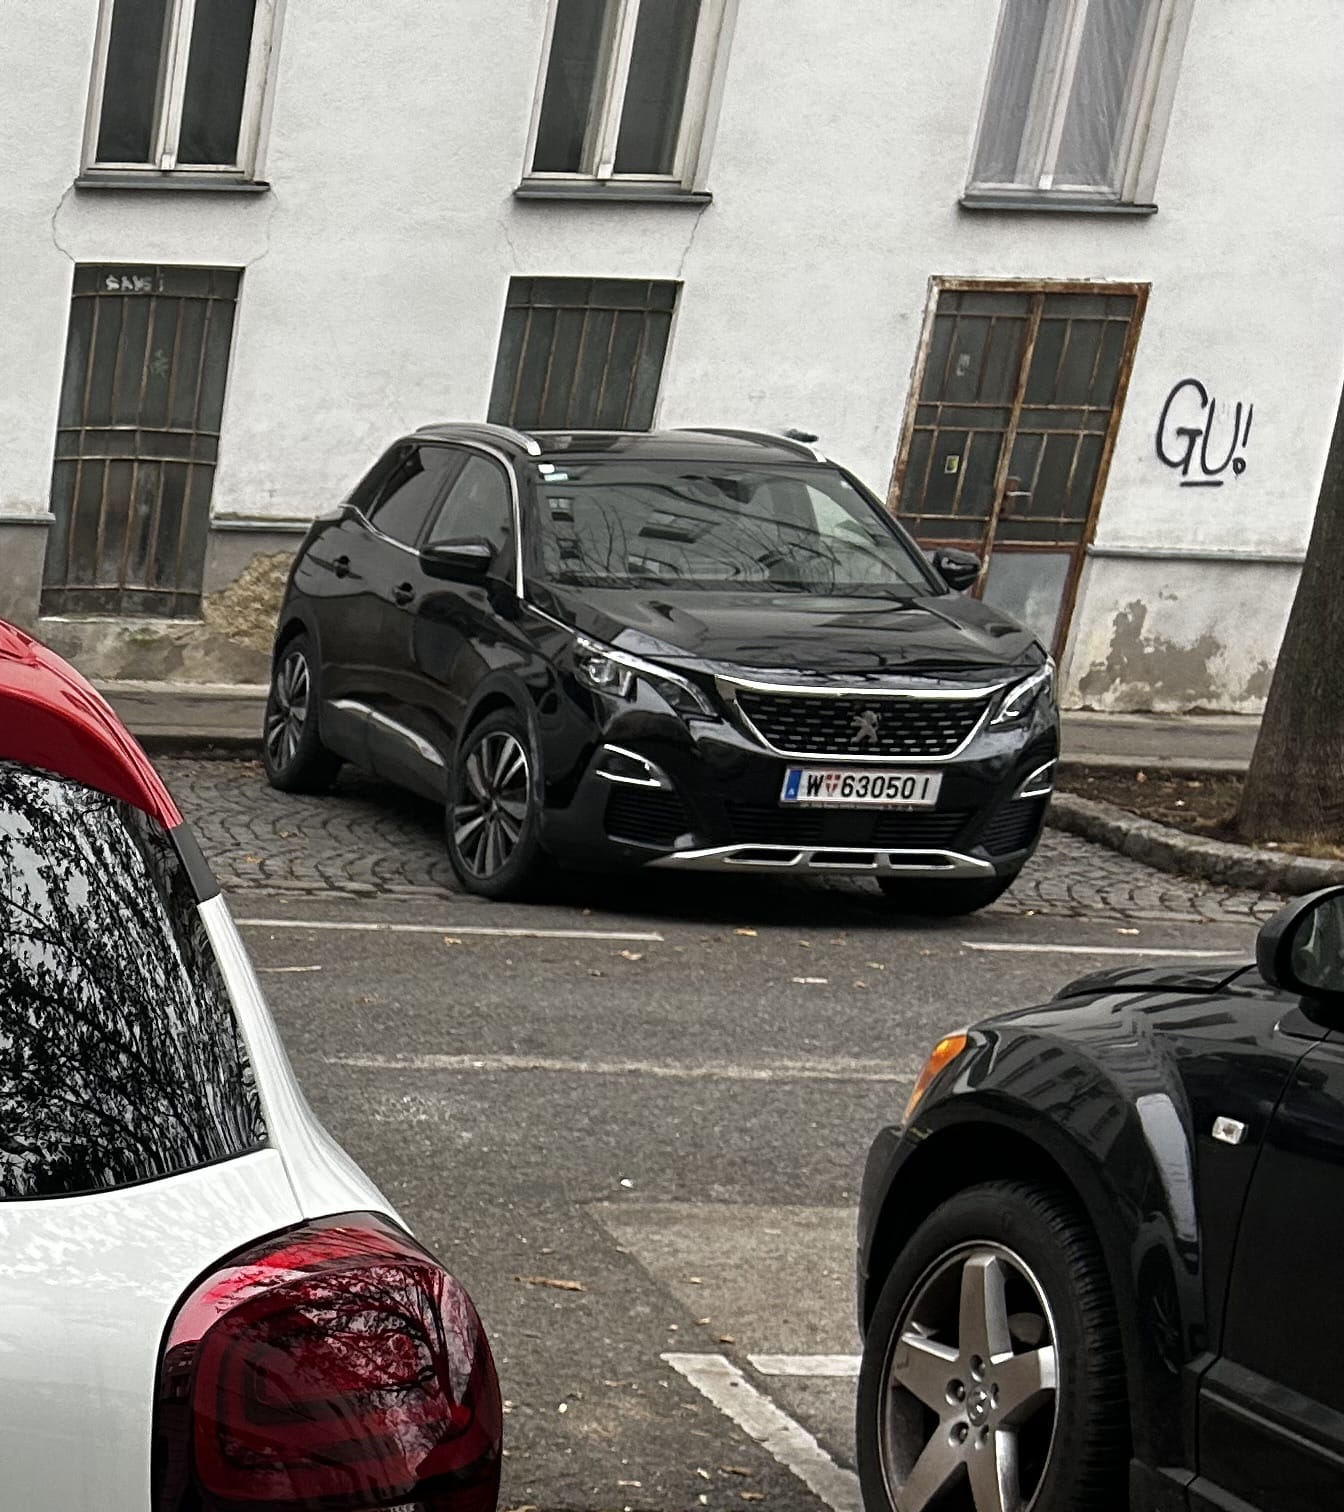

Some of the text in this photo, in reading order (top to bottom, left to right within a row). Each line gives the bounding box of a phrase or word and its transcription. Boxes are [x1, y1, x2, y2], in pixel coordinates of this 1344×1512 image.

[1155, 378, 1253, 480] GU!
[806, 774, 824, 797] W
[841, 775, 916, 799] 63050
